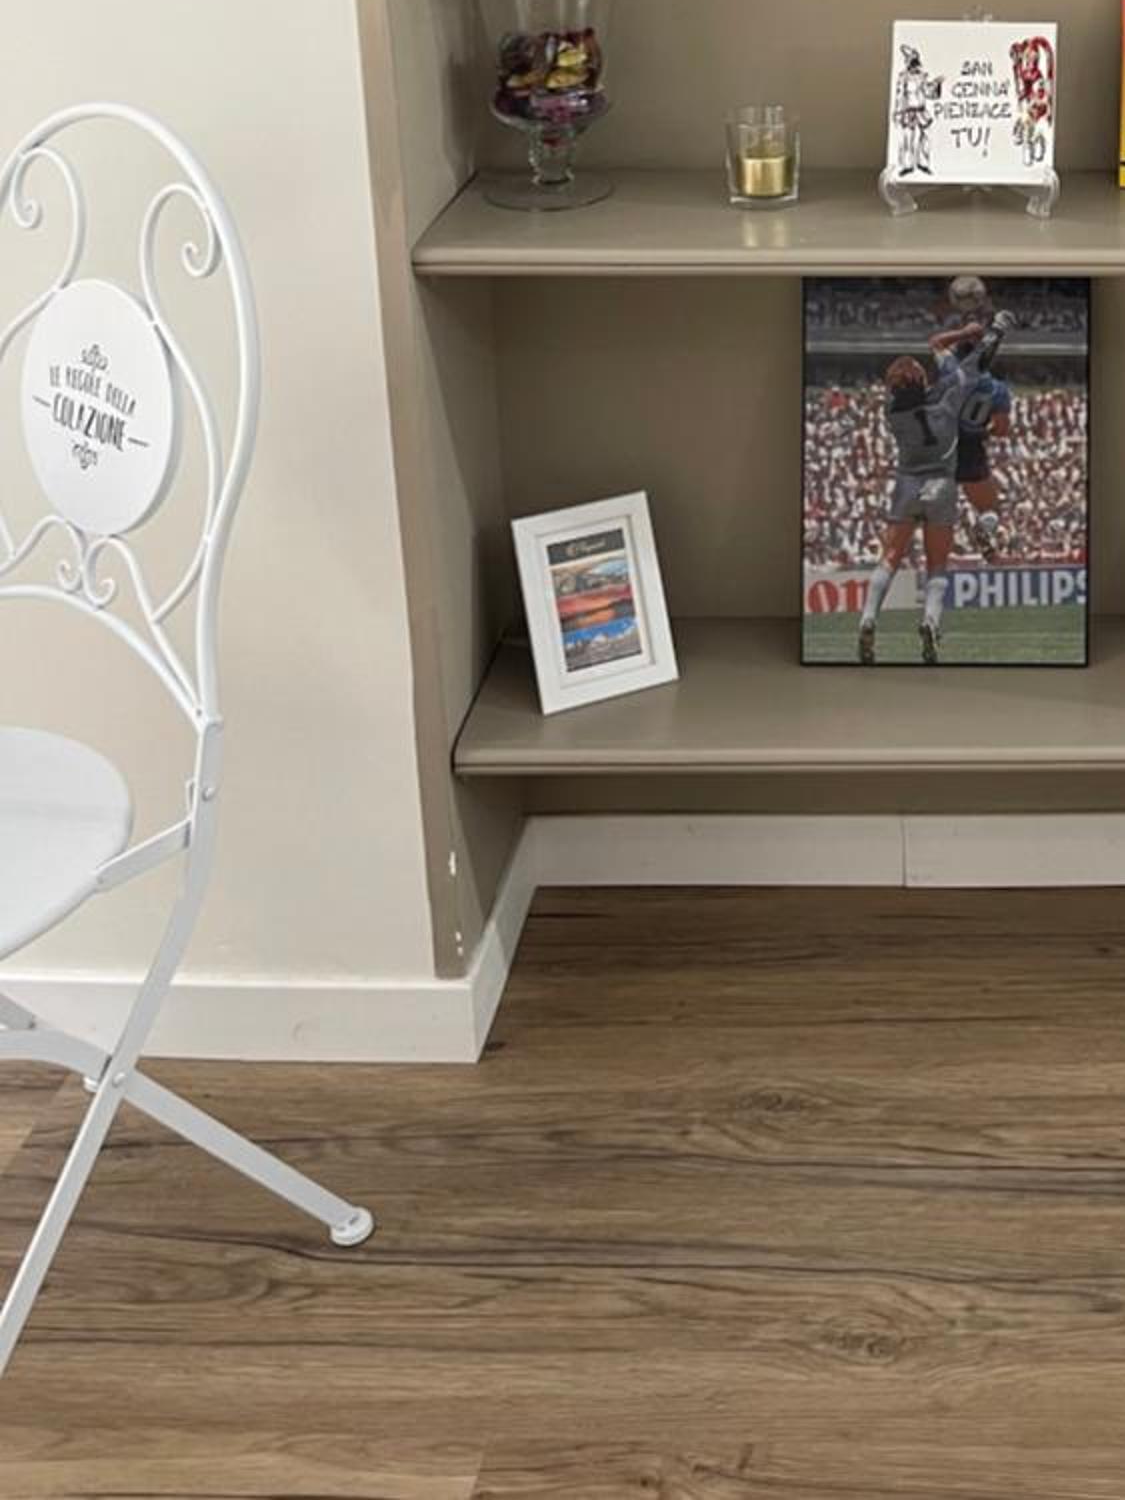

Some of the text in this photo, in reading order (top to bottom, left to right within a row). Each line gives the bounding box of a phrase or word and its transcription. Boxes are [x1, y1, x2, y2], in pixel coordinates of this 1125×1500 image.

[961, 61, 993, 76] SAN
[950, 126, 991, 158] TU!
[49, 365, 136, 417] LE REGOLE DELLA
[53, 392, 126, 452] COLAZIONE
